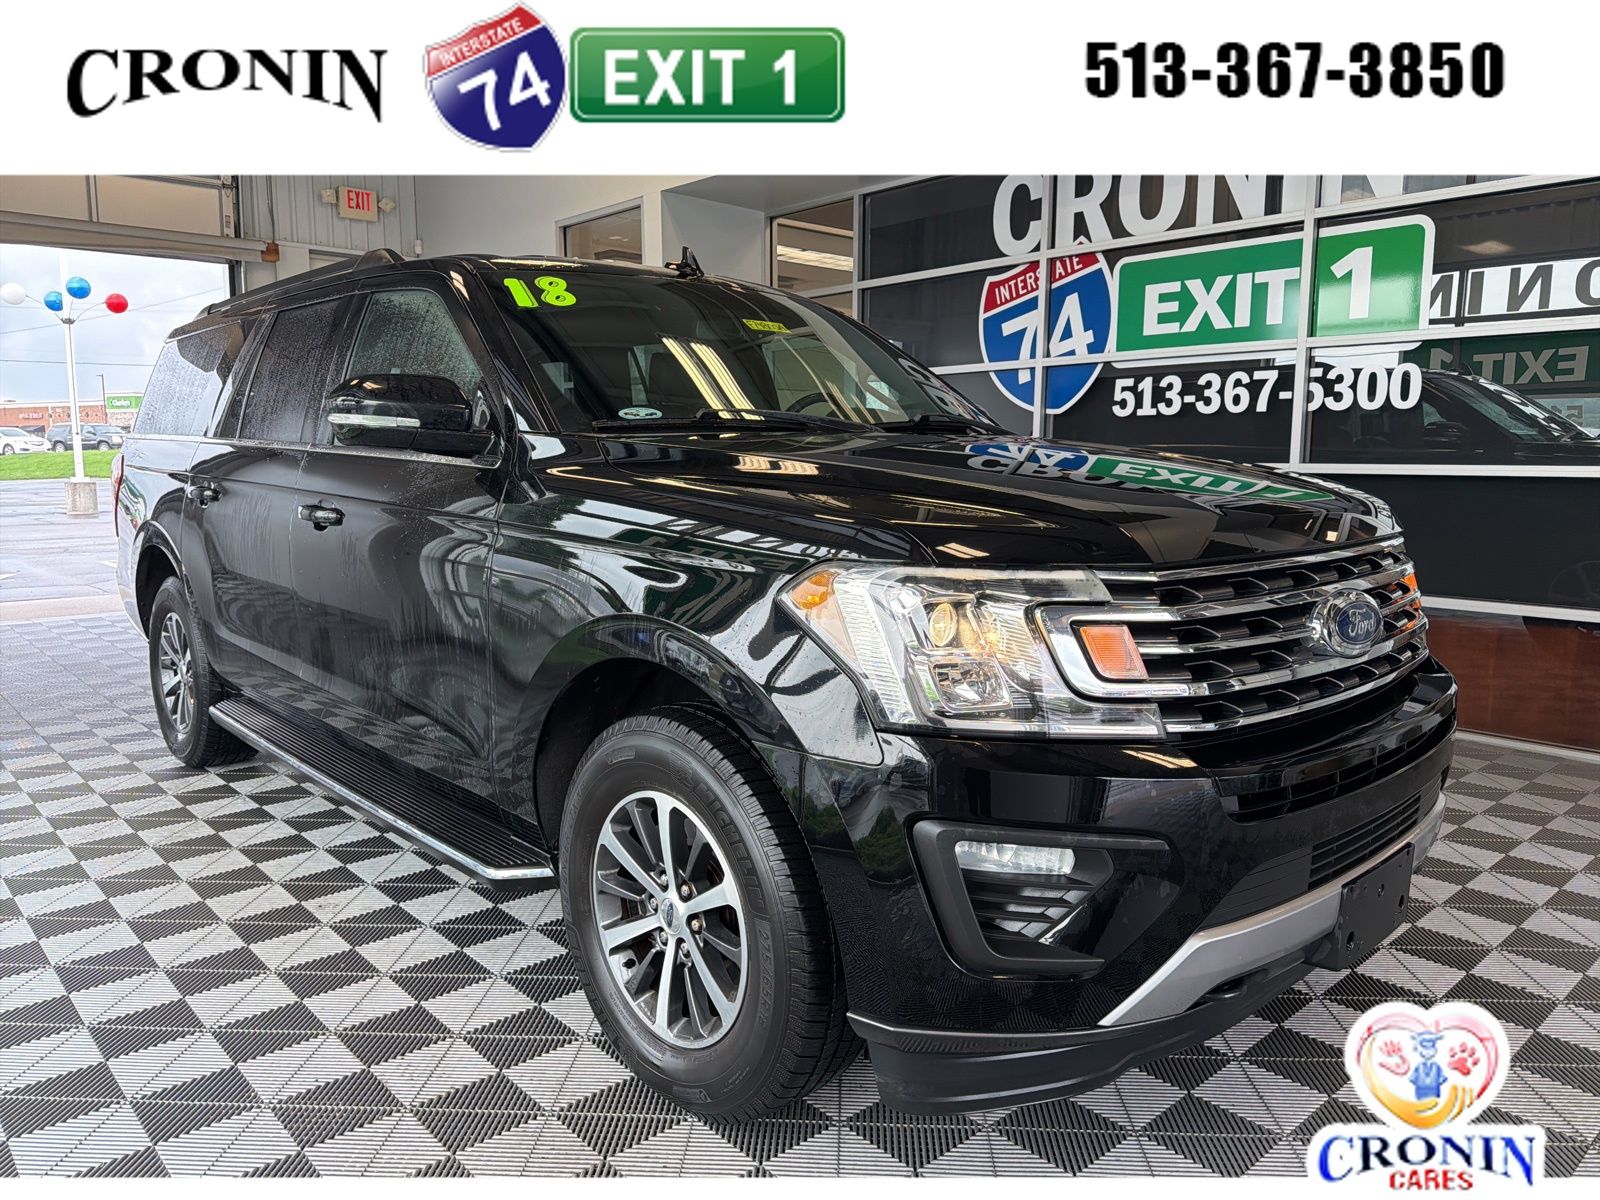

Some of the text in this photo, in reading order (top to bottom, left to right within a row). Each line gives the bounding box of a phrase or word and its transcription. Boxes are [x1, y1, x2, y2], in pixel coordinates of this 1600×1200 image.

[347, 189, 371, 211] EXIT
[503, 276, 576, 308] 18
[995, 253, 1083, 305] INTERSATE
[1143, 246, 1373, 336] EXIT 1
[1002, 292, 1095, 384] 74
[1112, 362, 1422, 417] 513-367-5300
[1347, 607, 1377, 637] Ford
